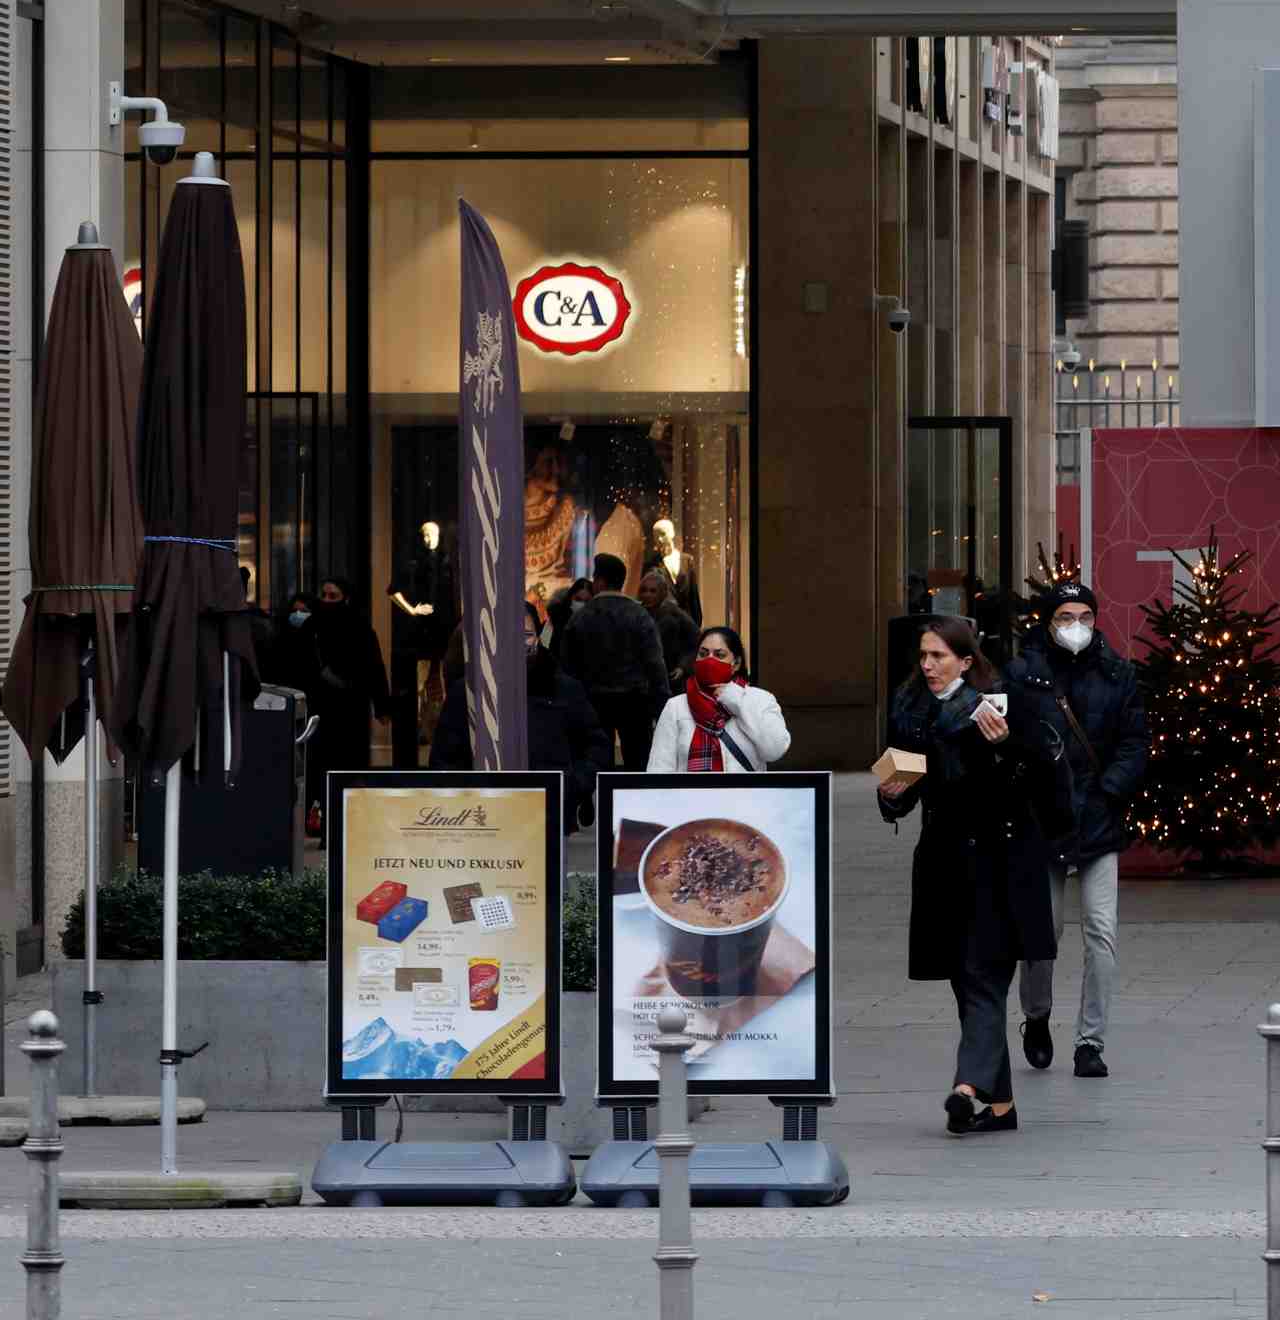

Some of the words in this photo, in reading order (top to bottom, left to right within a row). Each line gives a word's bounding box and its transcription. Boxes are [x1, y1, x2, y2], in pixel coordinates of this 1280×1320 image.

[533, 290, 608, 327] C&A
[415, 806, 472, 827] Lindt
[374, 858, 405, 870] JETZT
[409, 858, 434, 869] NEU
[438, 858, 466, 869] UND
[470, 858, 526, 870] EXKLUSIV
